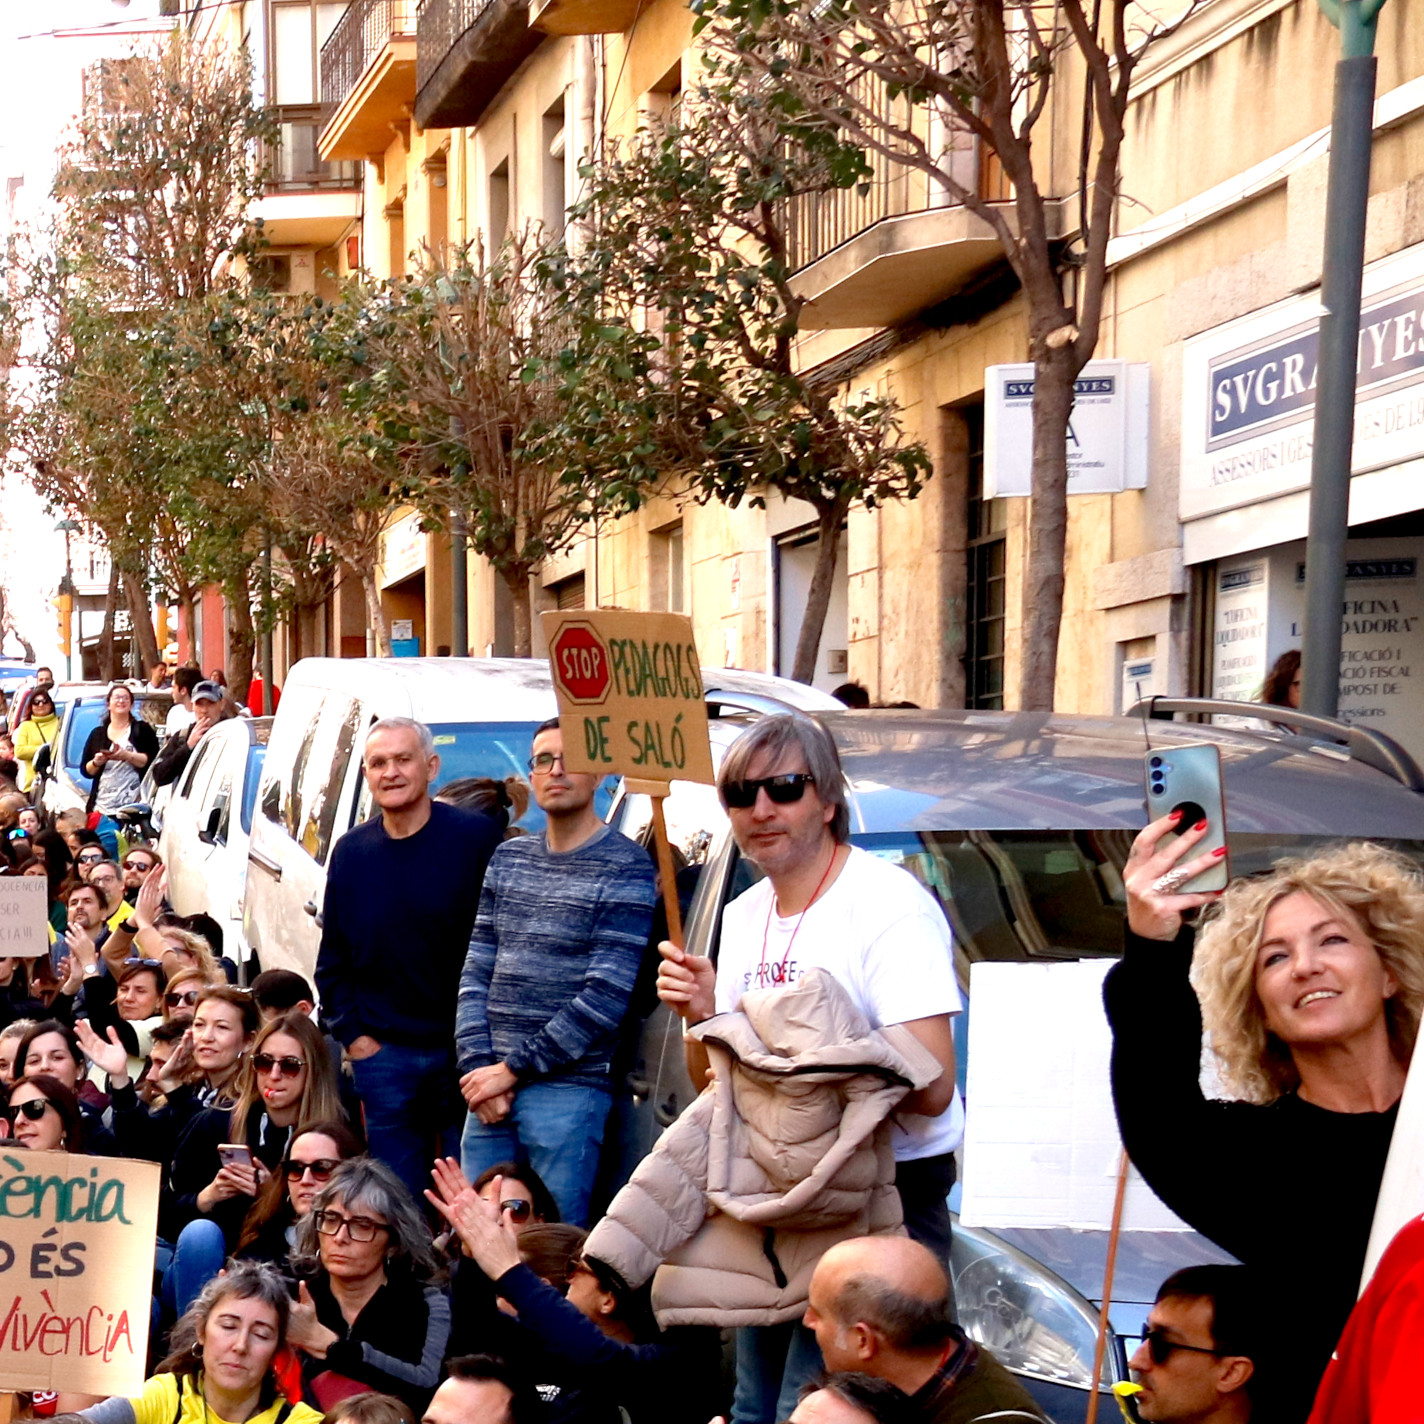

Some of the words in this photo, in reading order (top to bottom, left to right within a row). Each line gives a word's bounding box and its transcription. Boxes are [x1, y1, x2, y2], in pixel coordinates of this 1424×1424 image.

[562, 647, 601, 680] STOP
[609, 638, 701, 700] PEDAGOGS
[1370, 666, 1411, 678] FISCAL
[1382, 683, 1400, 695] DE
[583, 715, 612, 763] DE
[627, 712, 686, 770] SALÓ
[0, 902, 20, 915] SER
[30, 1227, 87, 1279] ÉS
